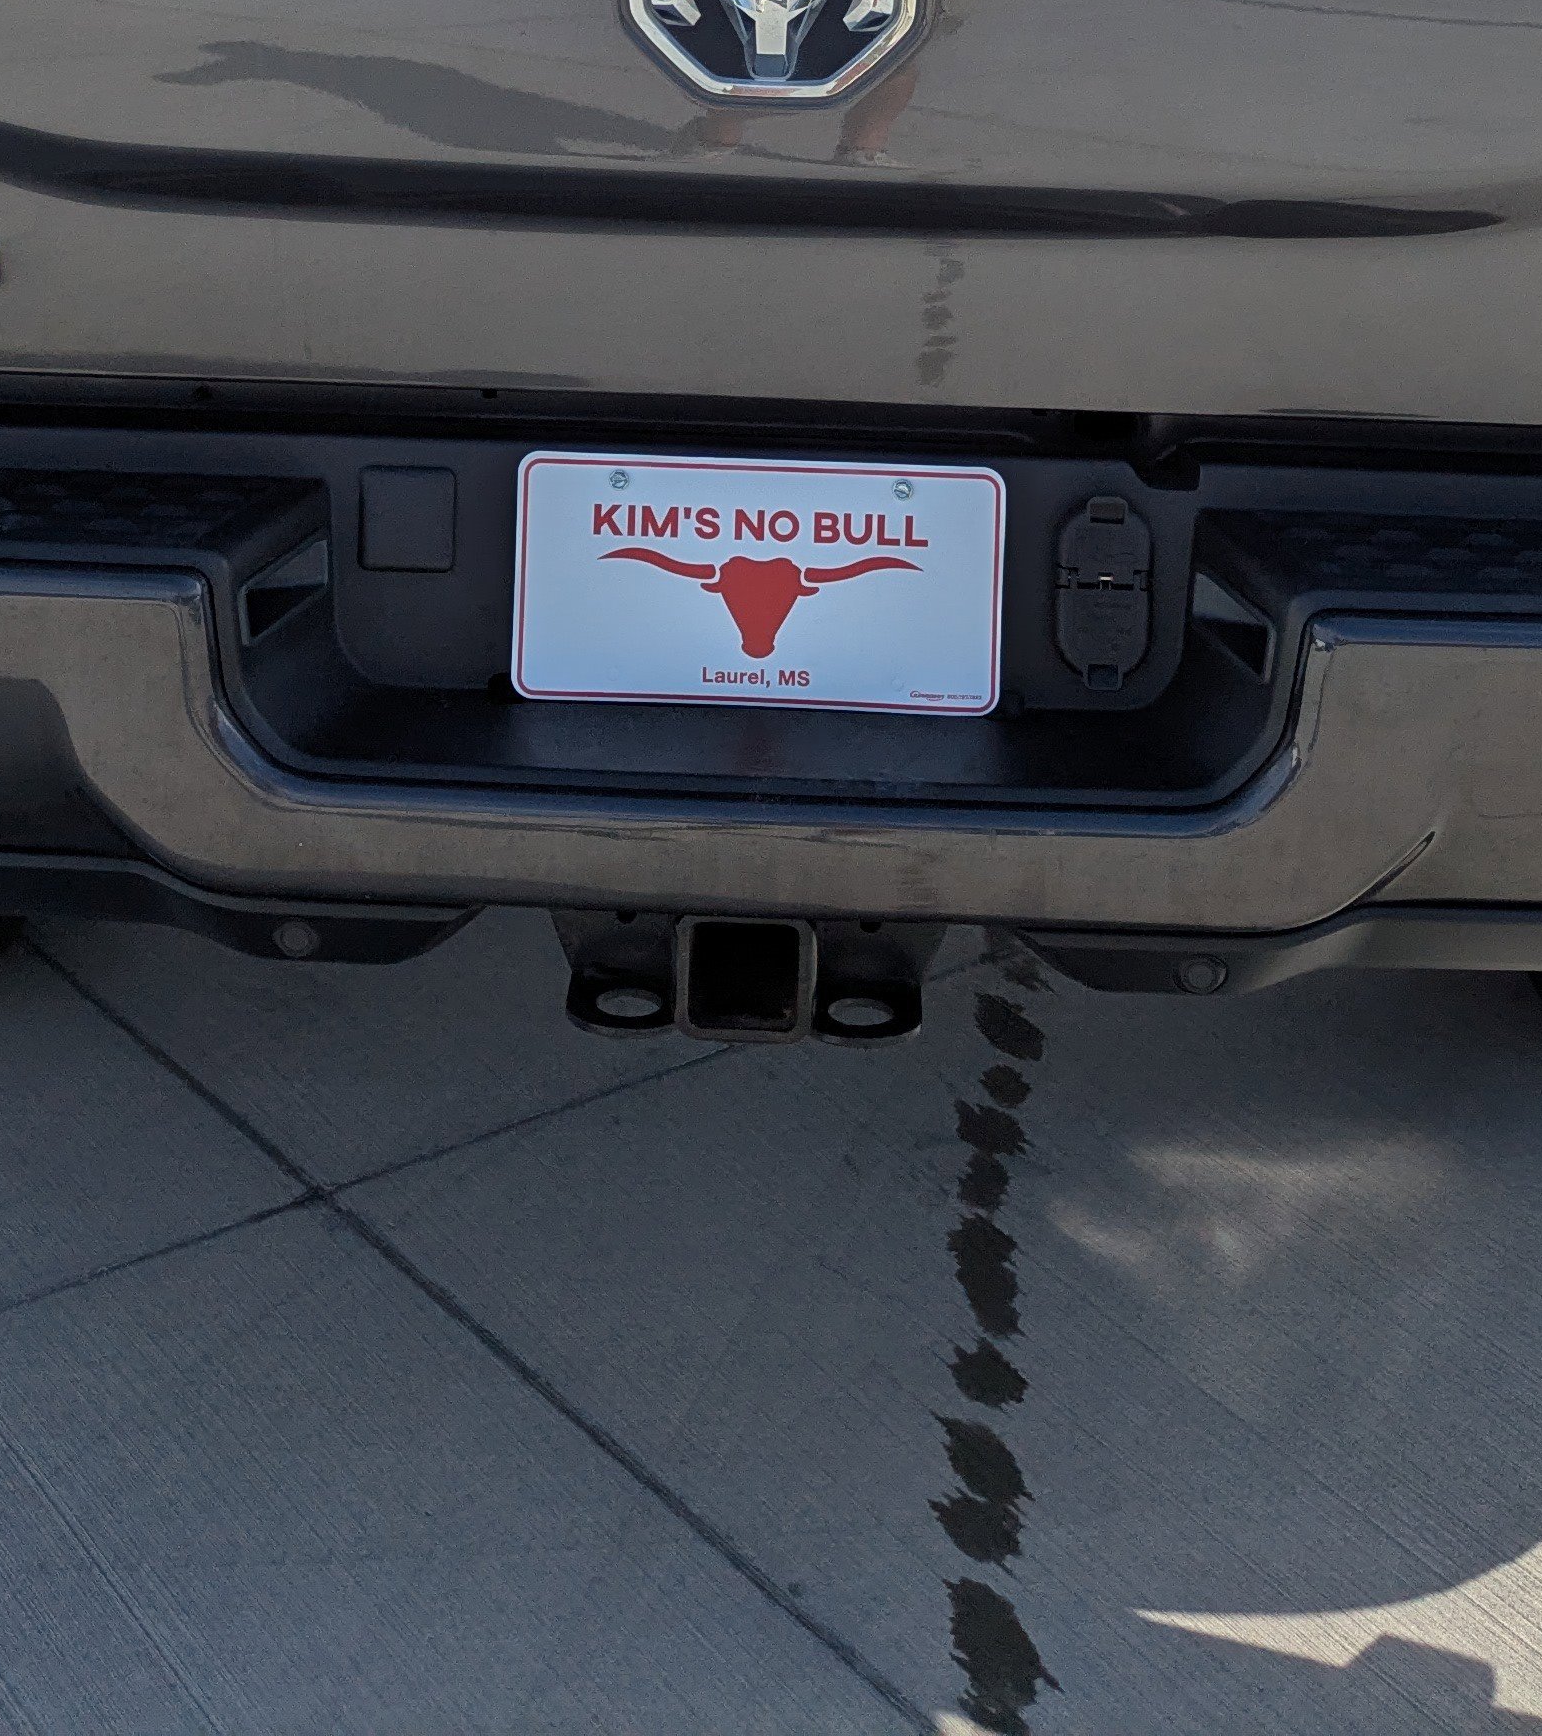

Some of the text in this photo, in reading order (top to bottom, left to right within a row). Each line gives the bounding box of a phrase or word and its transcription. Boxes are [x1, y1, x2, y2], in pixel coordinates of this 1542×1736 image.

[593, 503, 929, 548] KIM'S NO BULL
[702, 666, 811, 689] Laurel, MS
